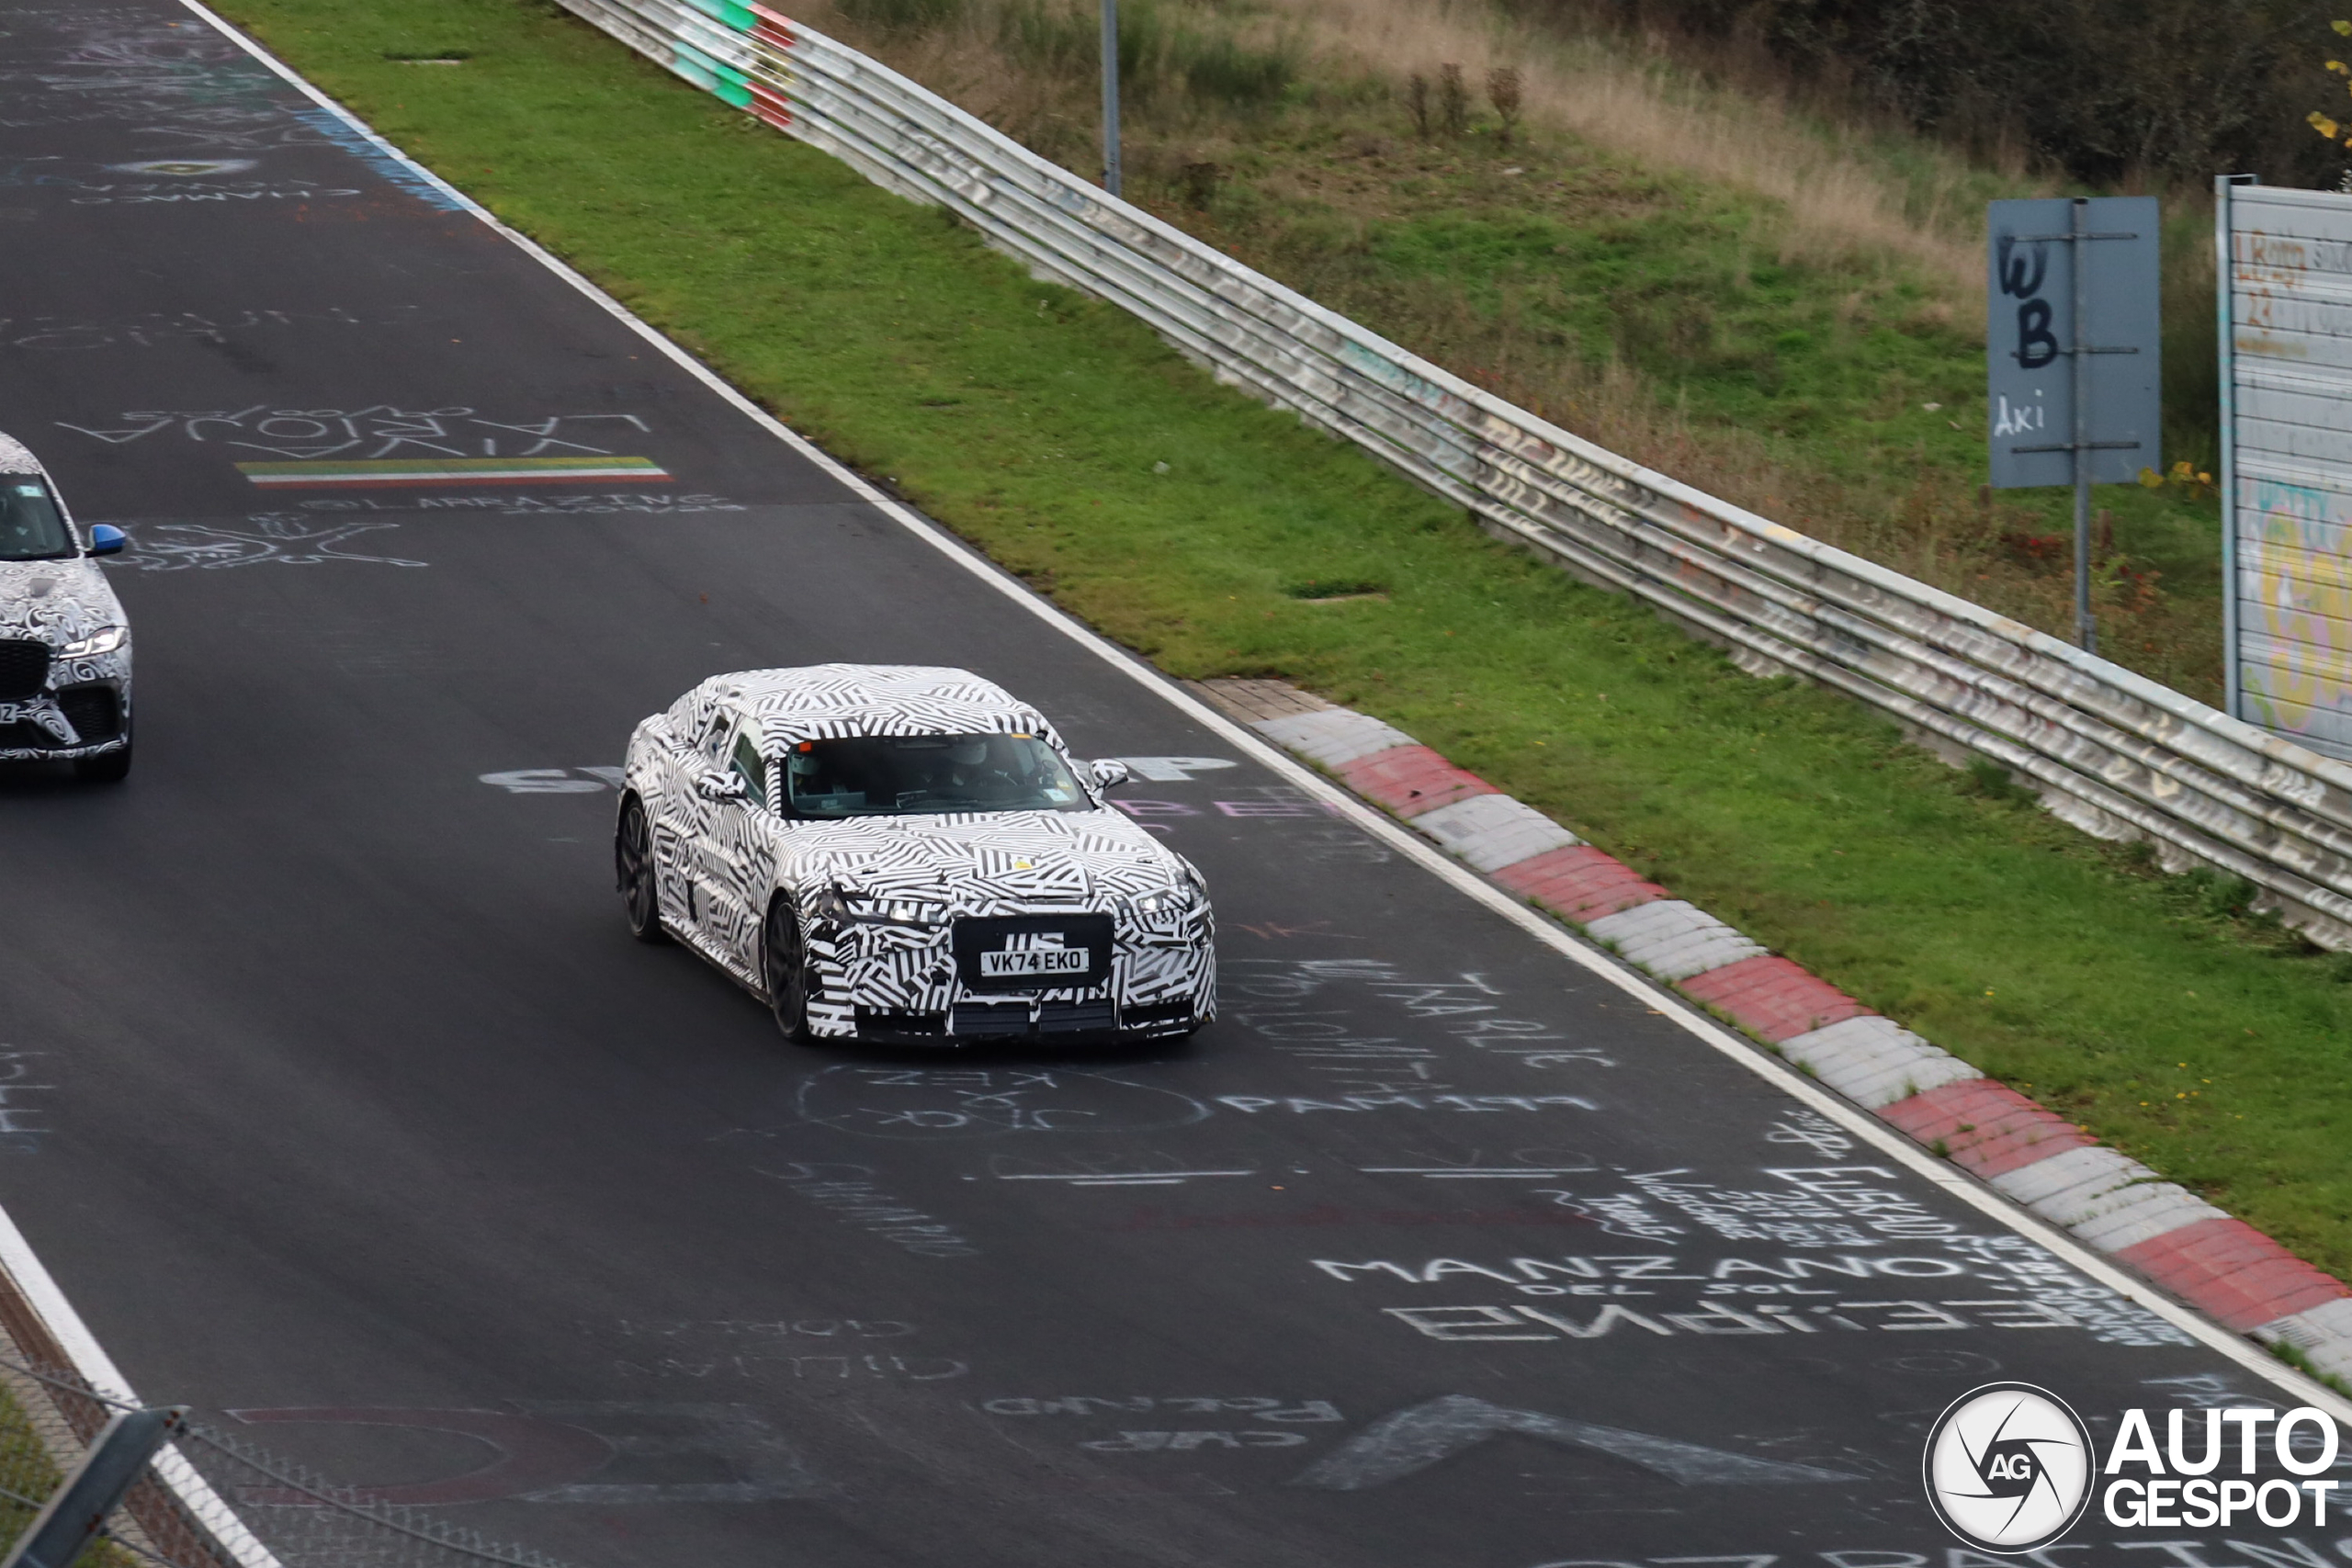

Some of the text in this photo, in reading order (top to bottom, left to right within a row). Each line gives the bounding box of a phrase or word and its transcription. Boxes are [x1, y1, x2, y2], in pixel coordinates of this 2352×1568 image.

[228, 436, 613, 459] VIVA
[989, 951, 1081, 973] VK74 EKO
[1309, 1255, 1966, 1283] MANZANO
[1517, 1282, 1840, 1297] DEL SOL
